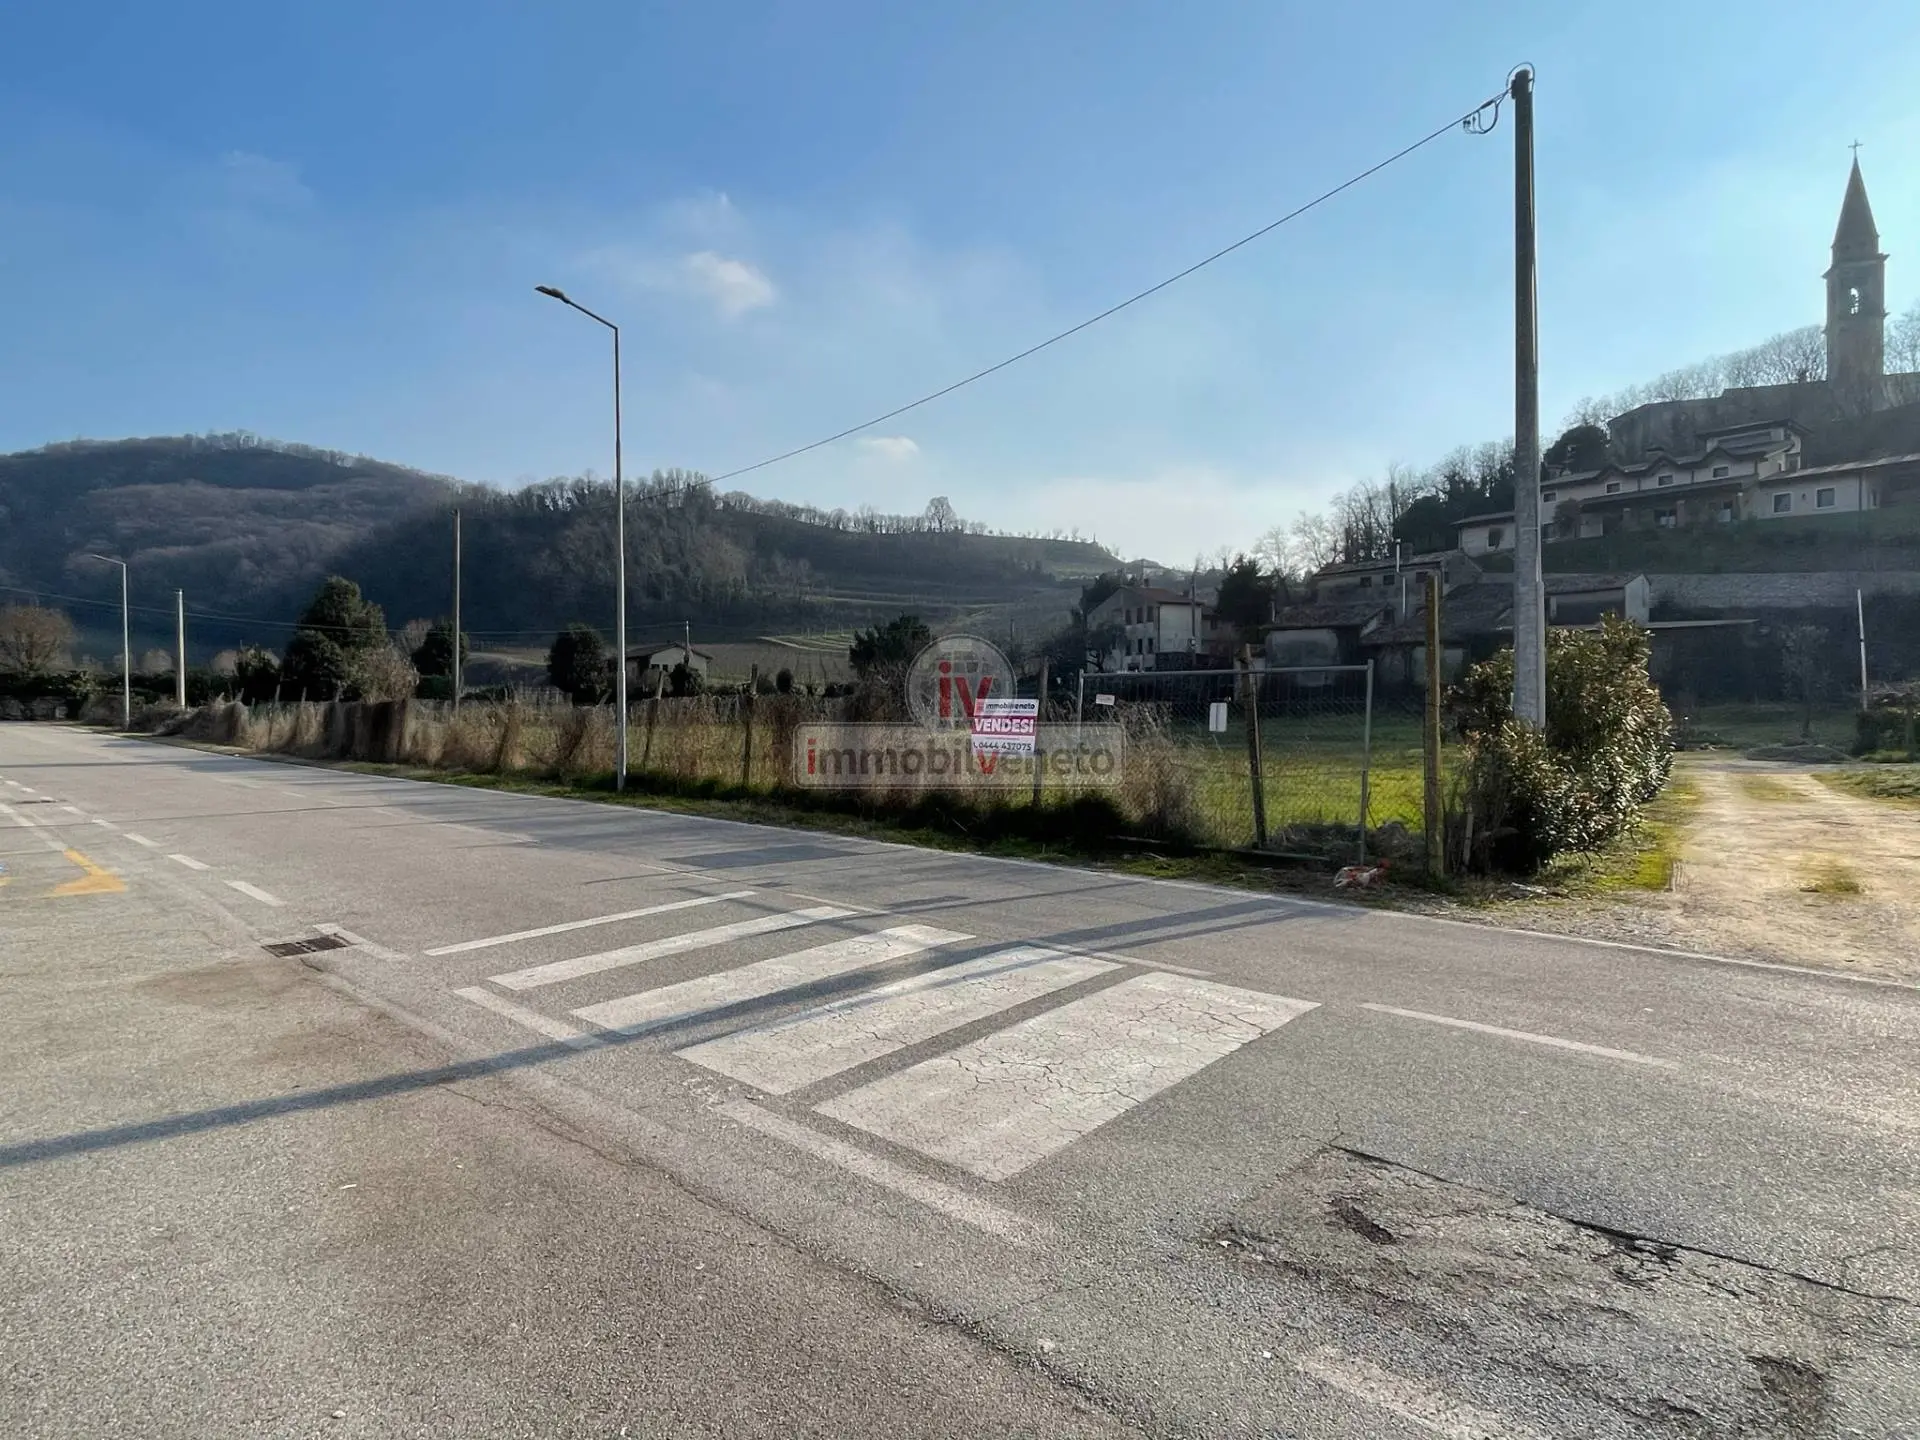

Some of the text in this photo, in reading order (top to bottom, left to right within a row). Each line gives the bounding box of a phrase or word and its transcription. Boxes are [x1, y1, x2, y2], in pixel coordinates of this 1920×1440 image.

[974, 718, 1034, 733] VENDESI
[978, 742, 1033, 751] 0444 437075
